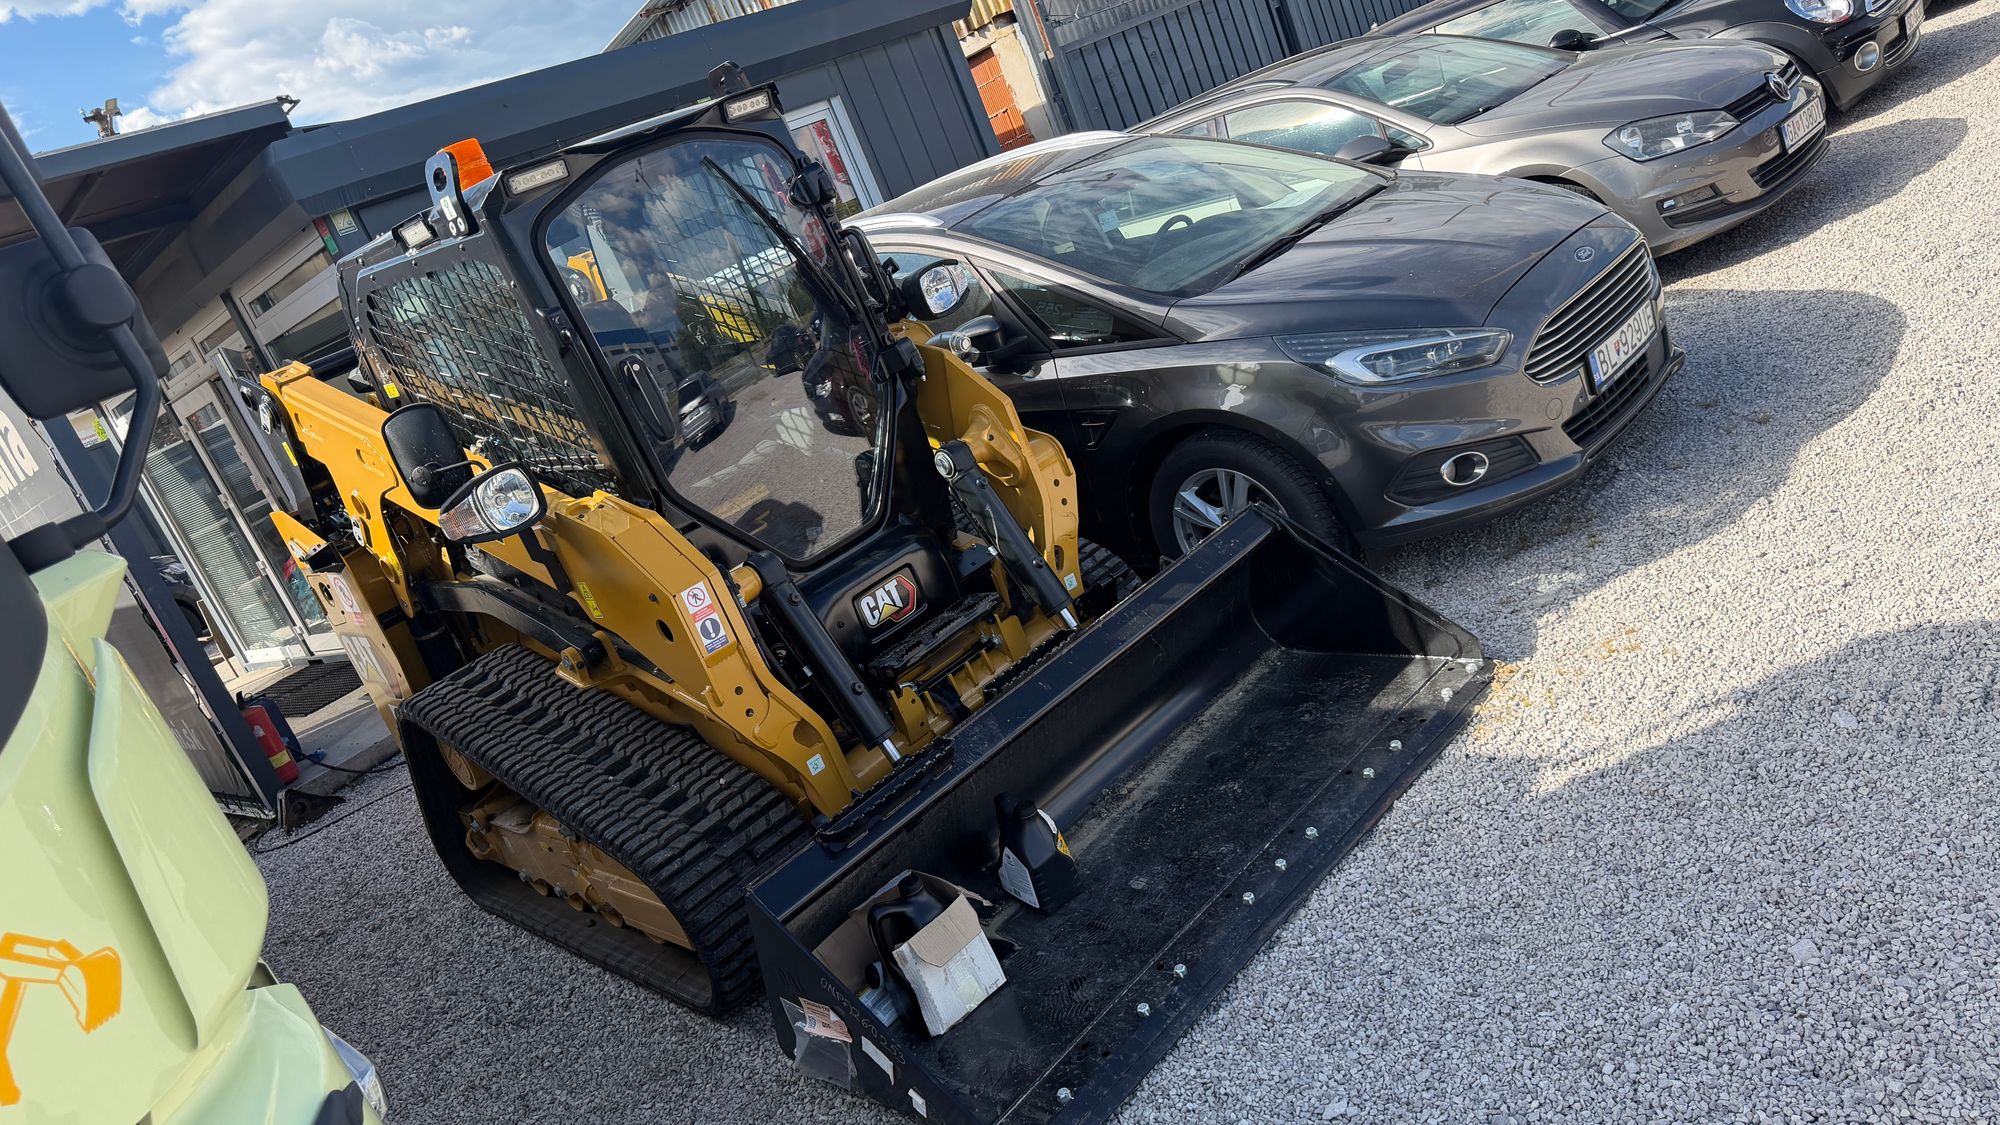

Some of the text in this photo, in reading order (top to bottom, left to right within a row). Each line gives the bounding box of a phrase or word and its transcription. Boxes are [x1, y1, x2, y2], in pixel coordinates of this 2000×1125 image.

[1598, 304, 1654, 377] BL 929UE
[861, 579, 903, 626] CAT
[341, 635, 390, 684] CAT
